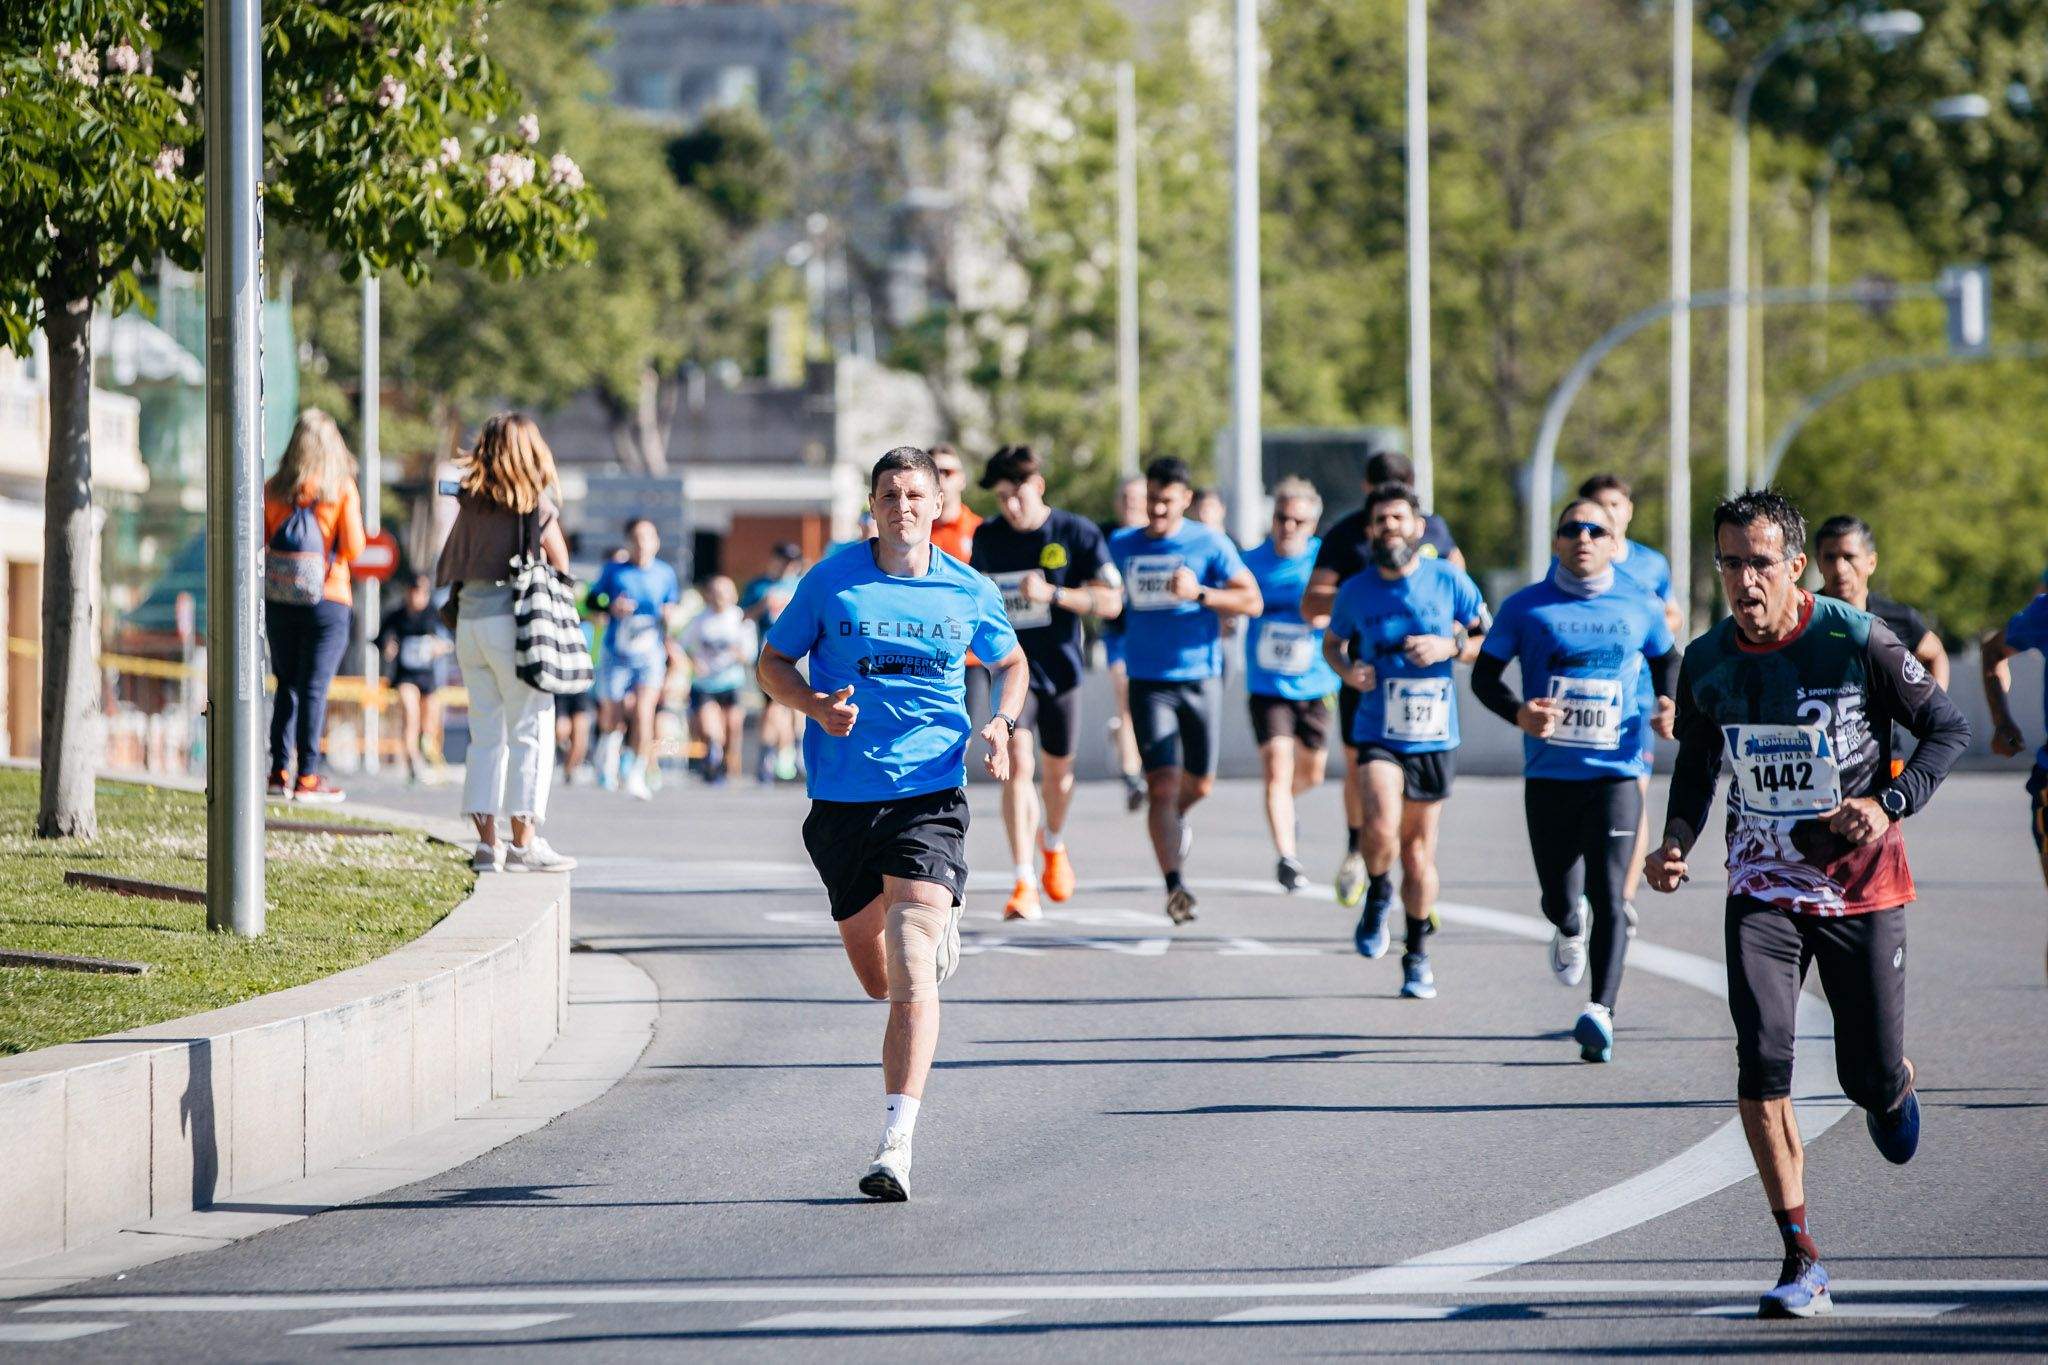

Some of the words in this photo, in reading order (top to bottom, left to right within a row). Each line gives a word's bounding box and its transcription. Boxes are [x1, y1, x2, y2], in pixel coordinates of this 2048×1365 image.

[839, 621, 962, 640] DECIMAS
[877, 655, 945, 668] BOMBEROS
[1562, 706, 1606, 728] 2100
[1758, 738, 1810, 747] BOMBEROS
[1755, 752, 1812, 763] DECIMAS
[1750, 761, 1814, 792] 1442
